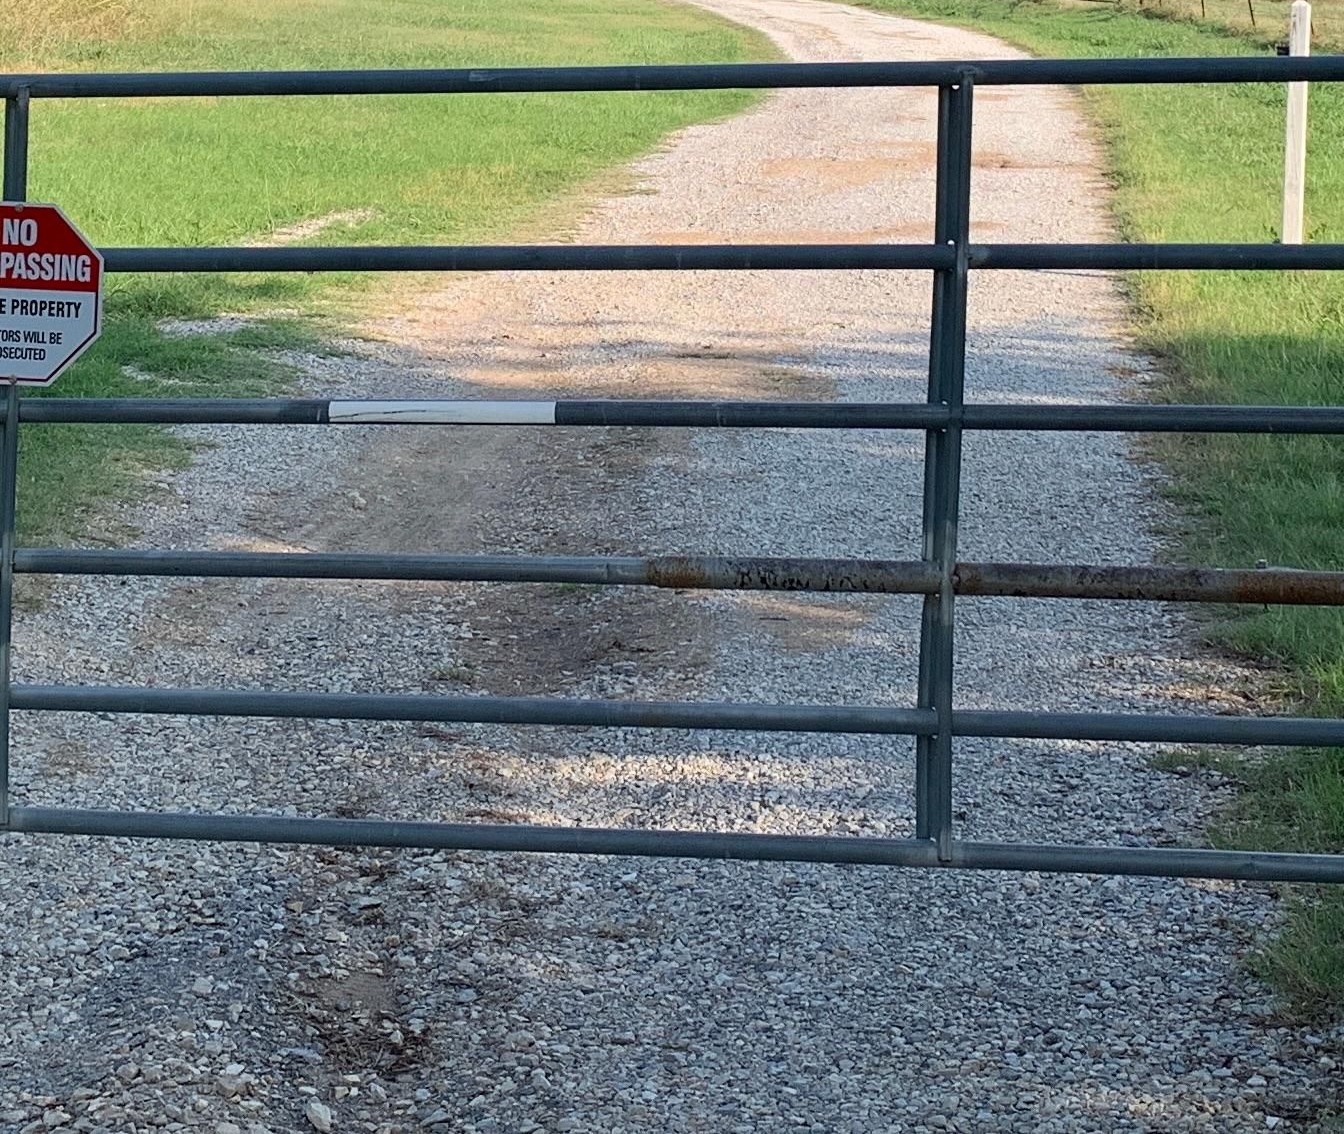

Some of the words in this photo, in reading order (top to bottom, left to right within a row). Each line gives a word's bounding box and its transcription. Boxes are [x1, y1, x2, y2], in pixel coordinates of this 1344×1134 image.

[2, 218, 38, 246] NO
[11, 298, 82, 318] PROPERTY
[23, 331, 47, 344] WILL
[49, 332, 63, 345] BE
